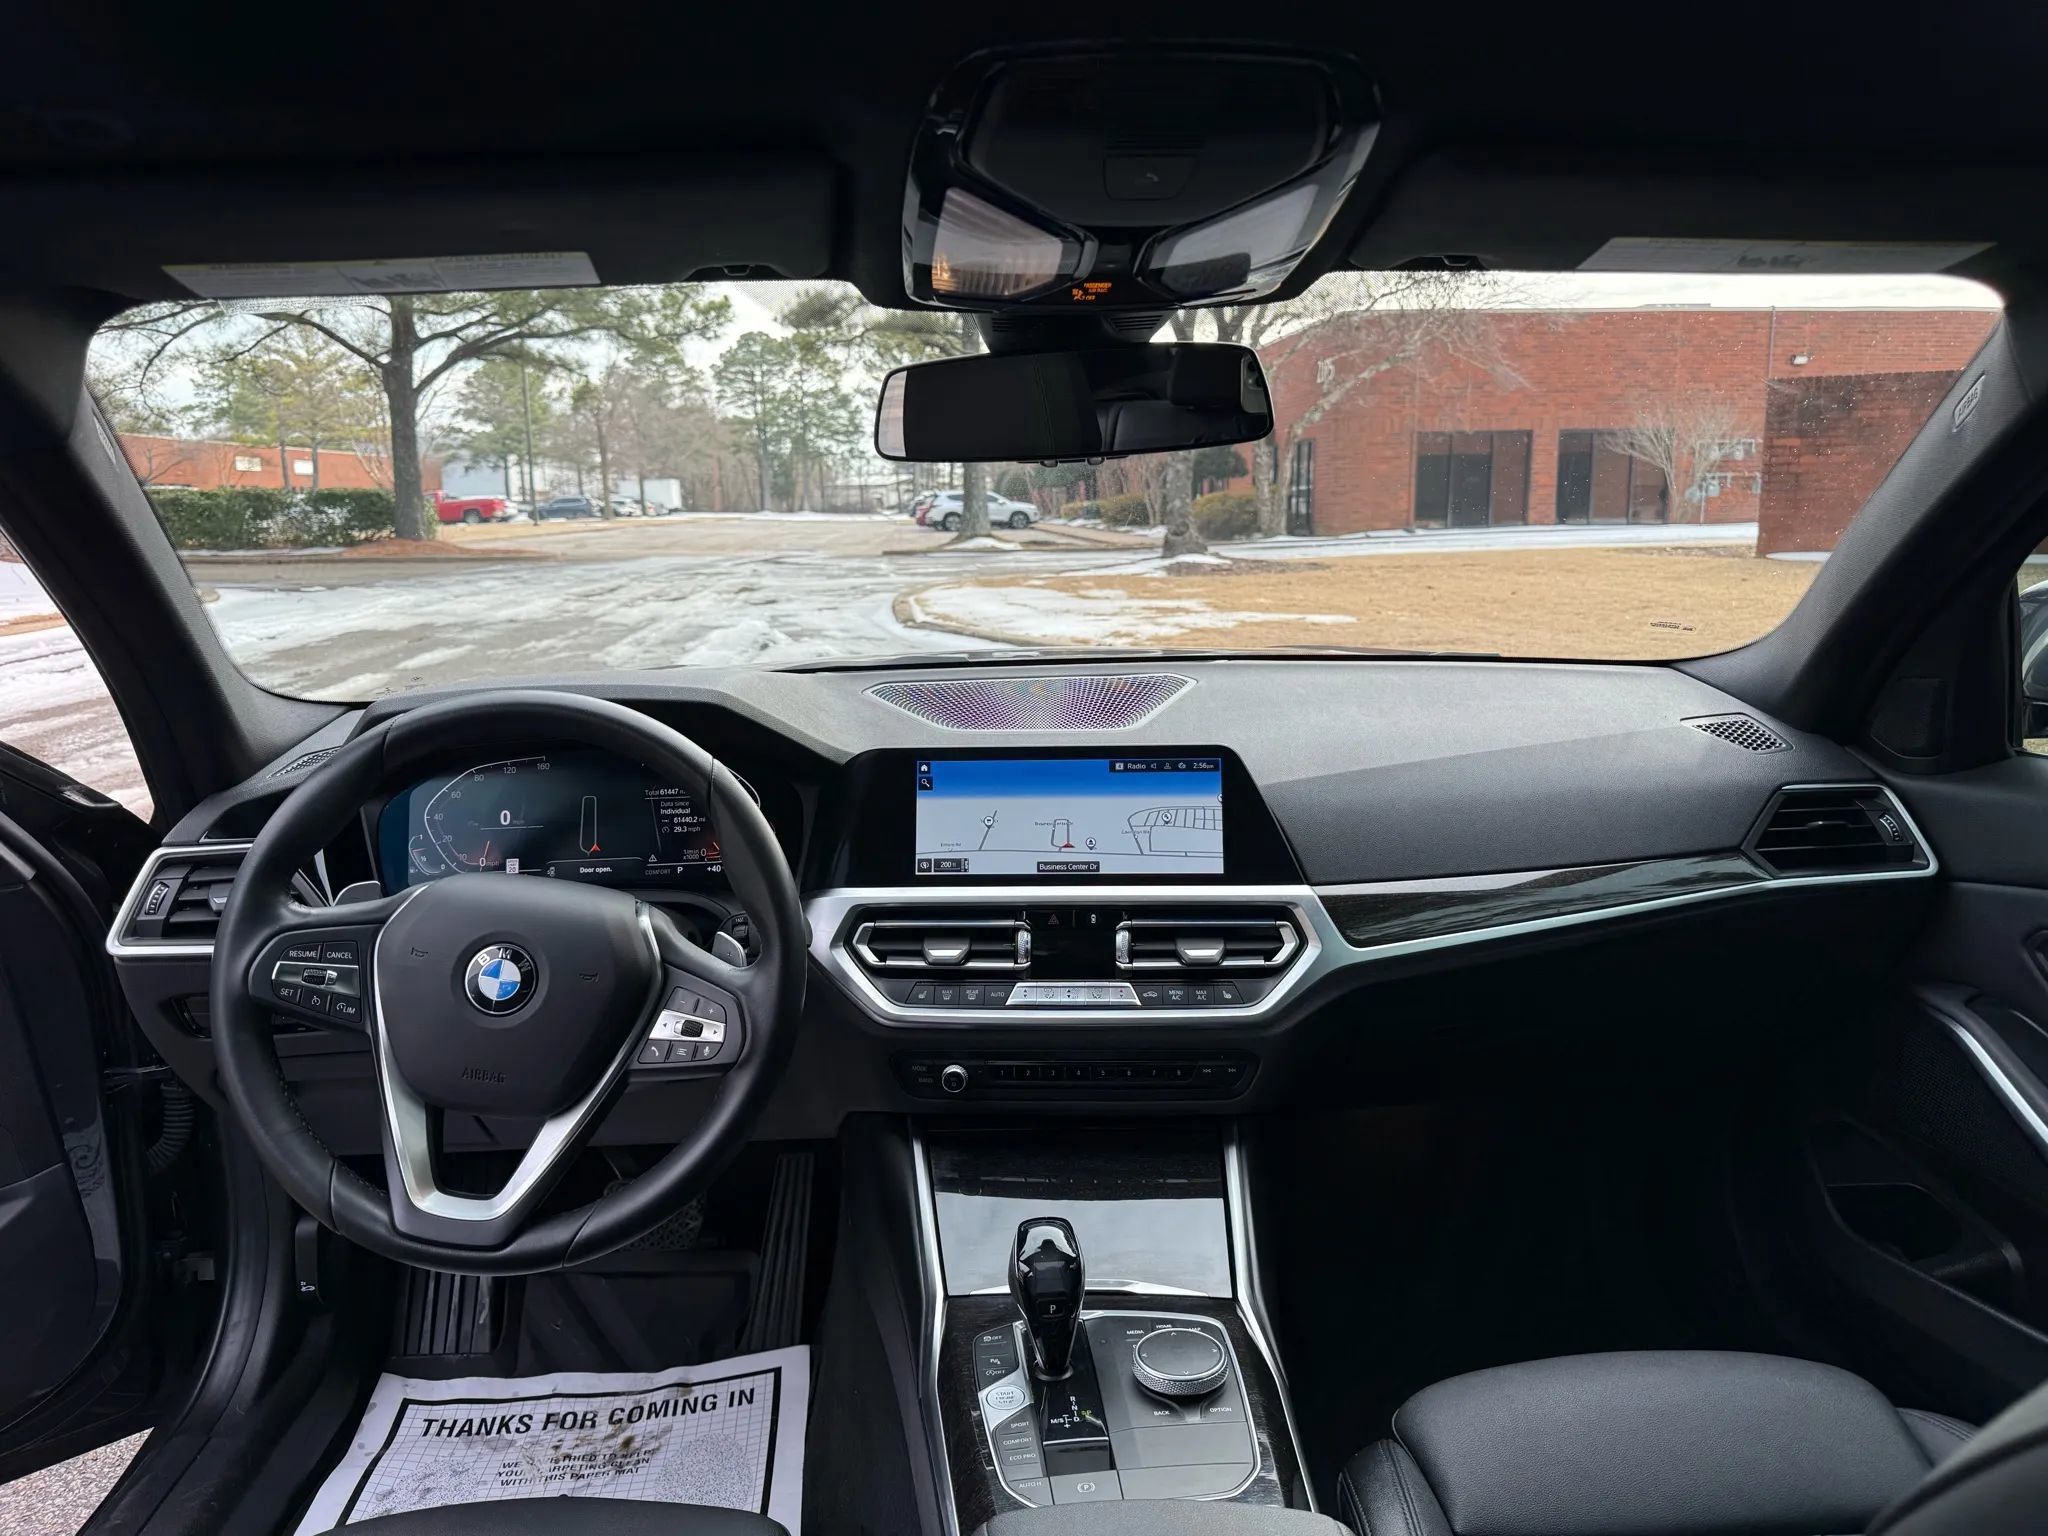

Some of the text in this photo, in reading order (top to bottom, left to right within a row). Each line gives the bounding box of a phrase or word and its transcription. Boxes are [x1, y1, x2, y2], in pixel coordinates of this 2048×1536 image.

[500, 810, 511, 825] 0
[700, 848, 707, 856] 0
[479, 857, 486, 867] 0
[478, 948, 531, 972] BMW
[280, 988, 294, 996] SET
[343, 1006, 356, 1014] LIM
[462, 1068, 506, 1084] AIRBAG
[1050, 1305, 1056, 1313] P
[422, 1387, 756, 1438] THANKS FOR COMING IN
[1003, 1437, 1032, 1445] COMFORT
[549, 1462, 607, 1472] RPETING
[500, 1478, 532, 1486] WITH
[615, 1467, 640, 1476] MAT
